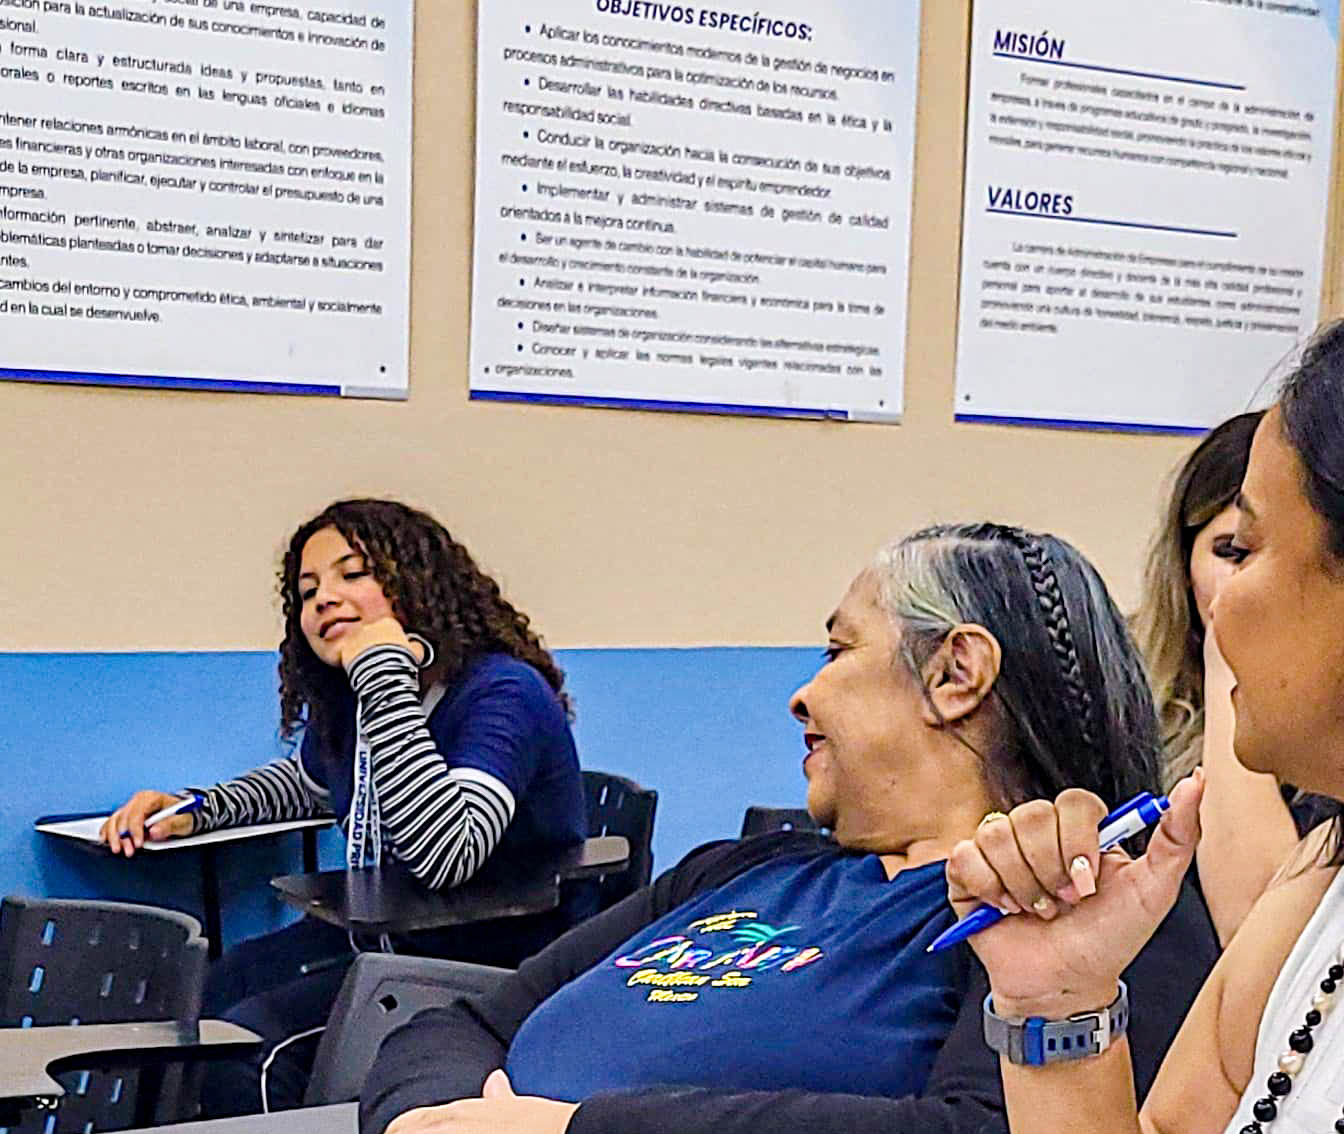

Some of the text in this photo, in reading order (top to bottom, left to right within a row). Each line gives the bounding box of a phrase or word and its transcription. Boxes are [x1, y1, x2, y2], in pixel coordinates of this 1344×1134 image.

[596, 0, 811, 40] OBJETIVOS ESPECÍFICOS:
[993, 29, 1065, 59] MISIÓN
[988, 186, 1073, 214] VALORES
